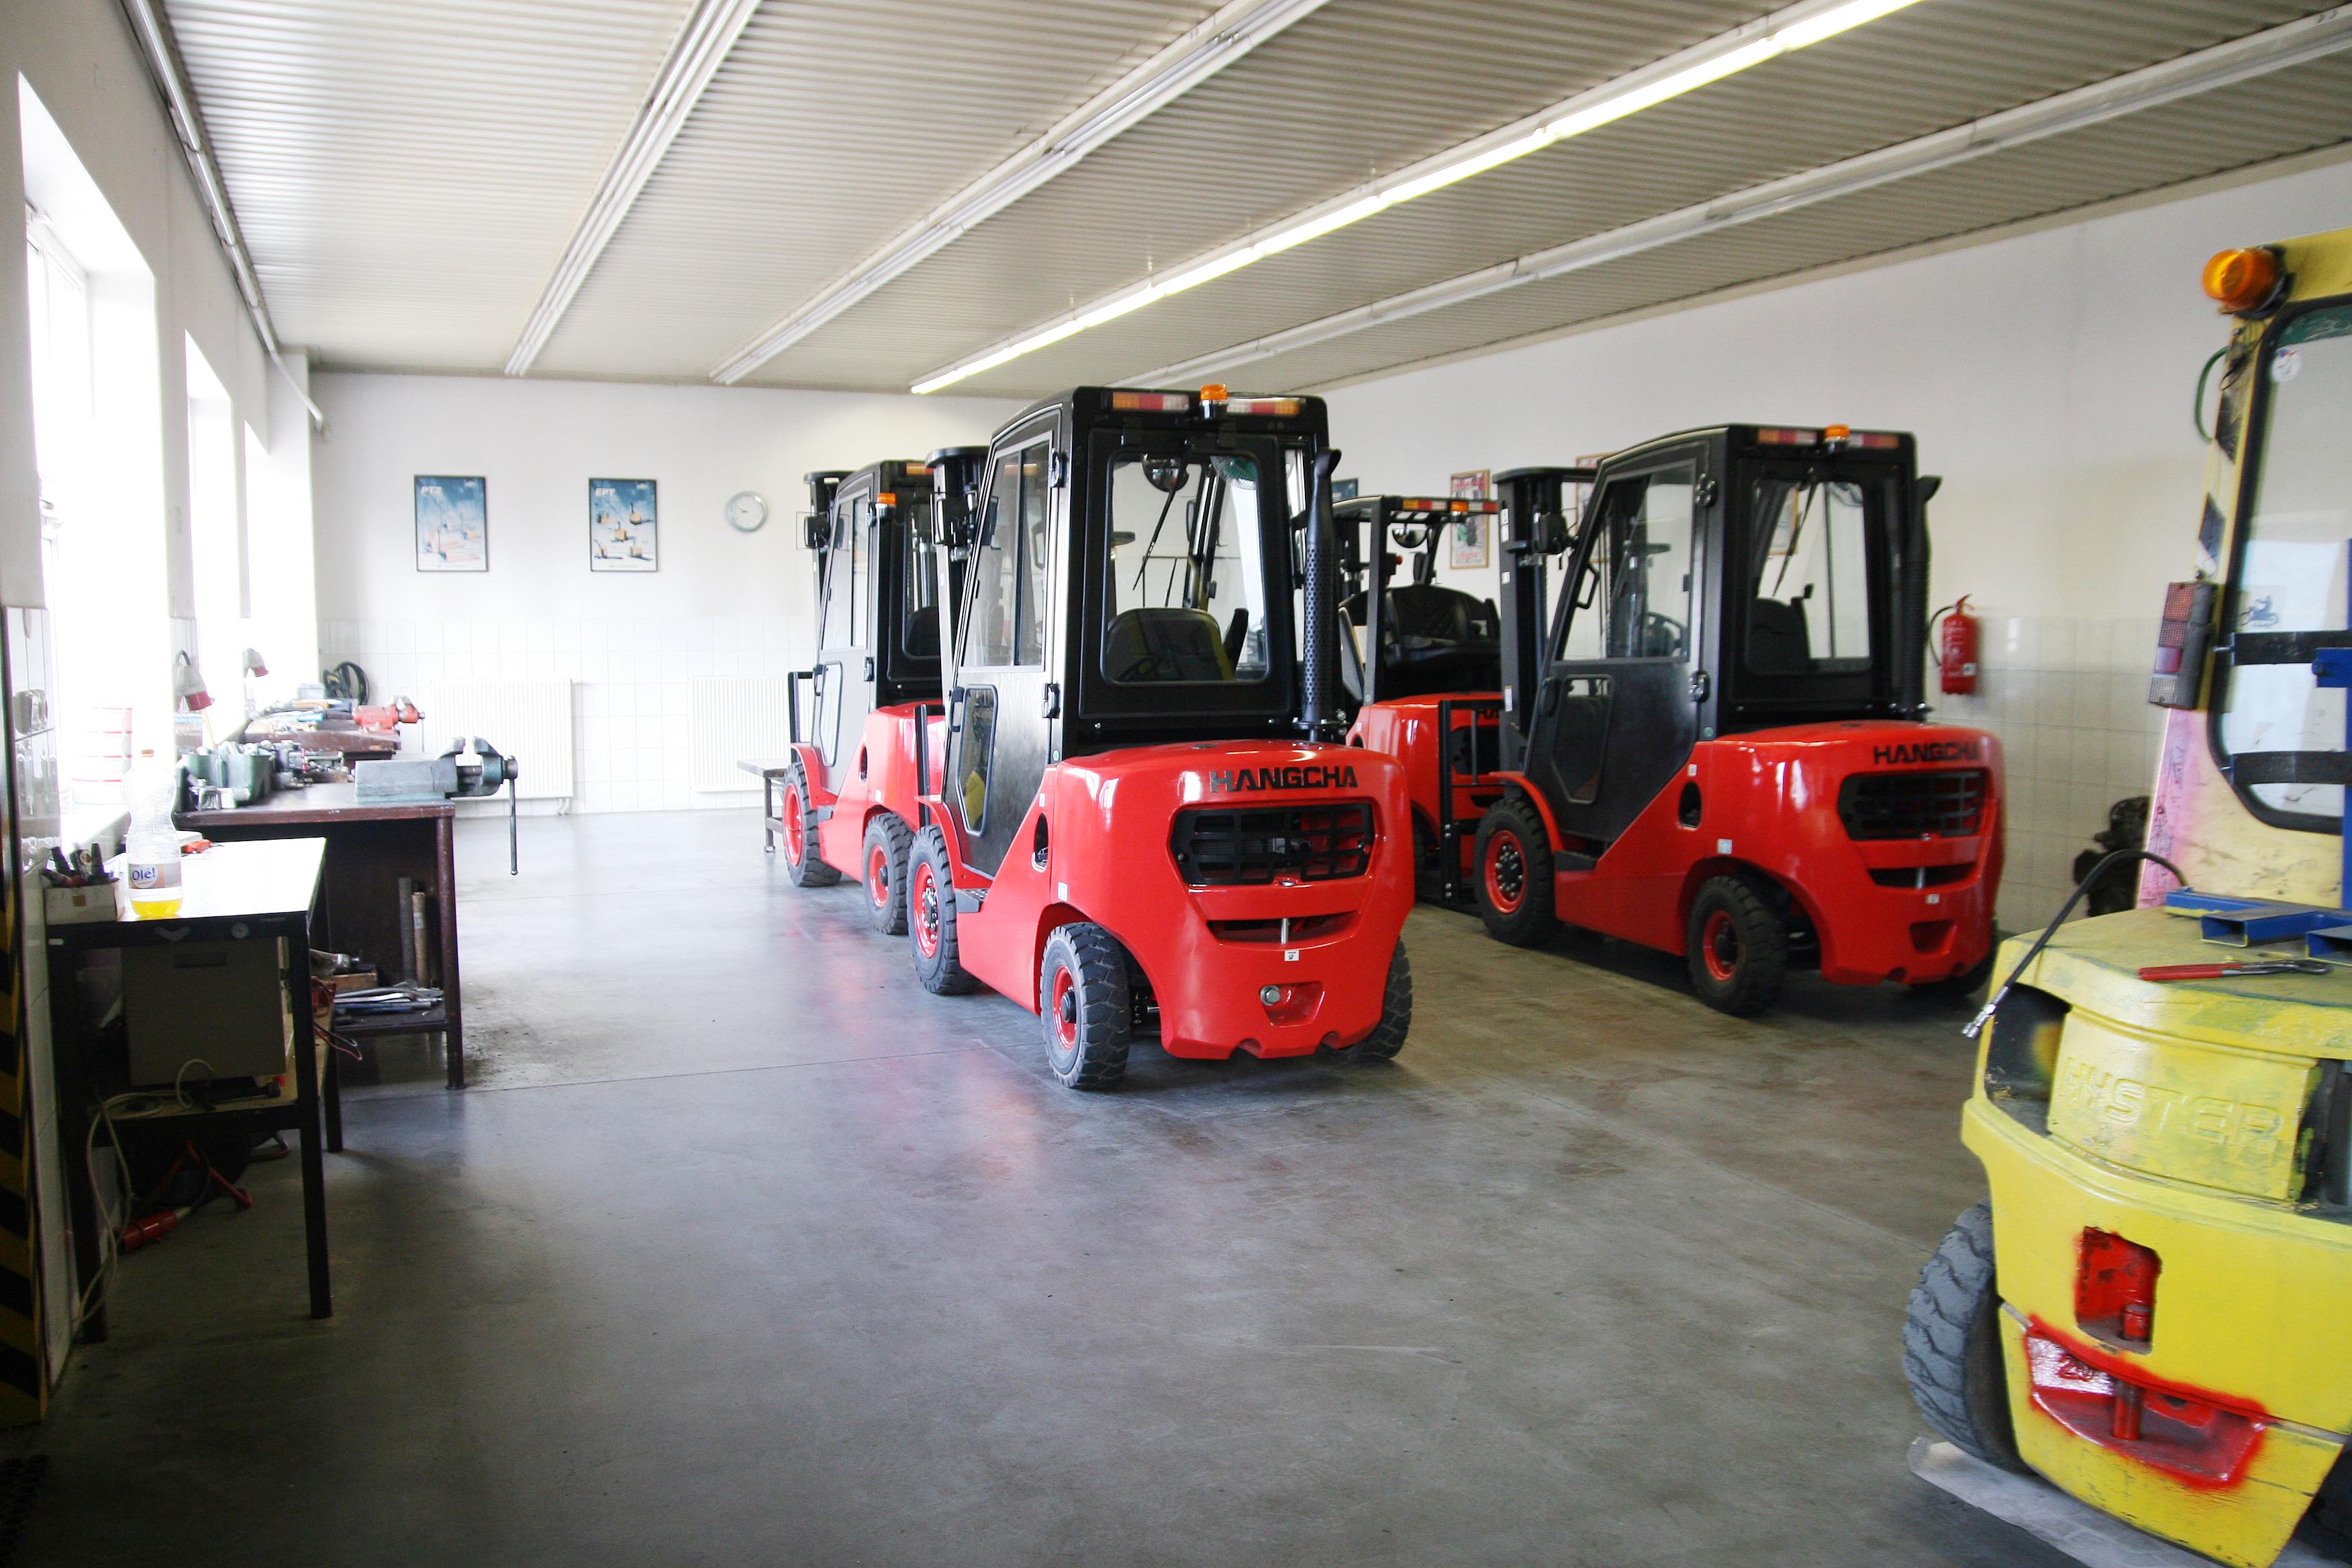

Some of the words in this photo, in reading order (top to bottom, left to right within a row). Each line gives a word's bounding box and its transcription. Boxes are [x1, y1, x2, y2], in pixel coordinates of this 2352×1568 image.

[595, 487, 616, 497] EPT
[1873, 741, 1981, 764] HANGCHA
[1210, 765, 1359, 793] HANGCHA
[2058, 1057, 2284, 1168] HYSTER
